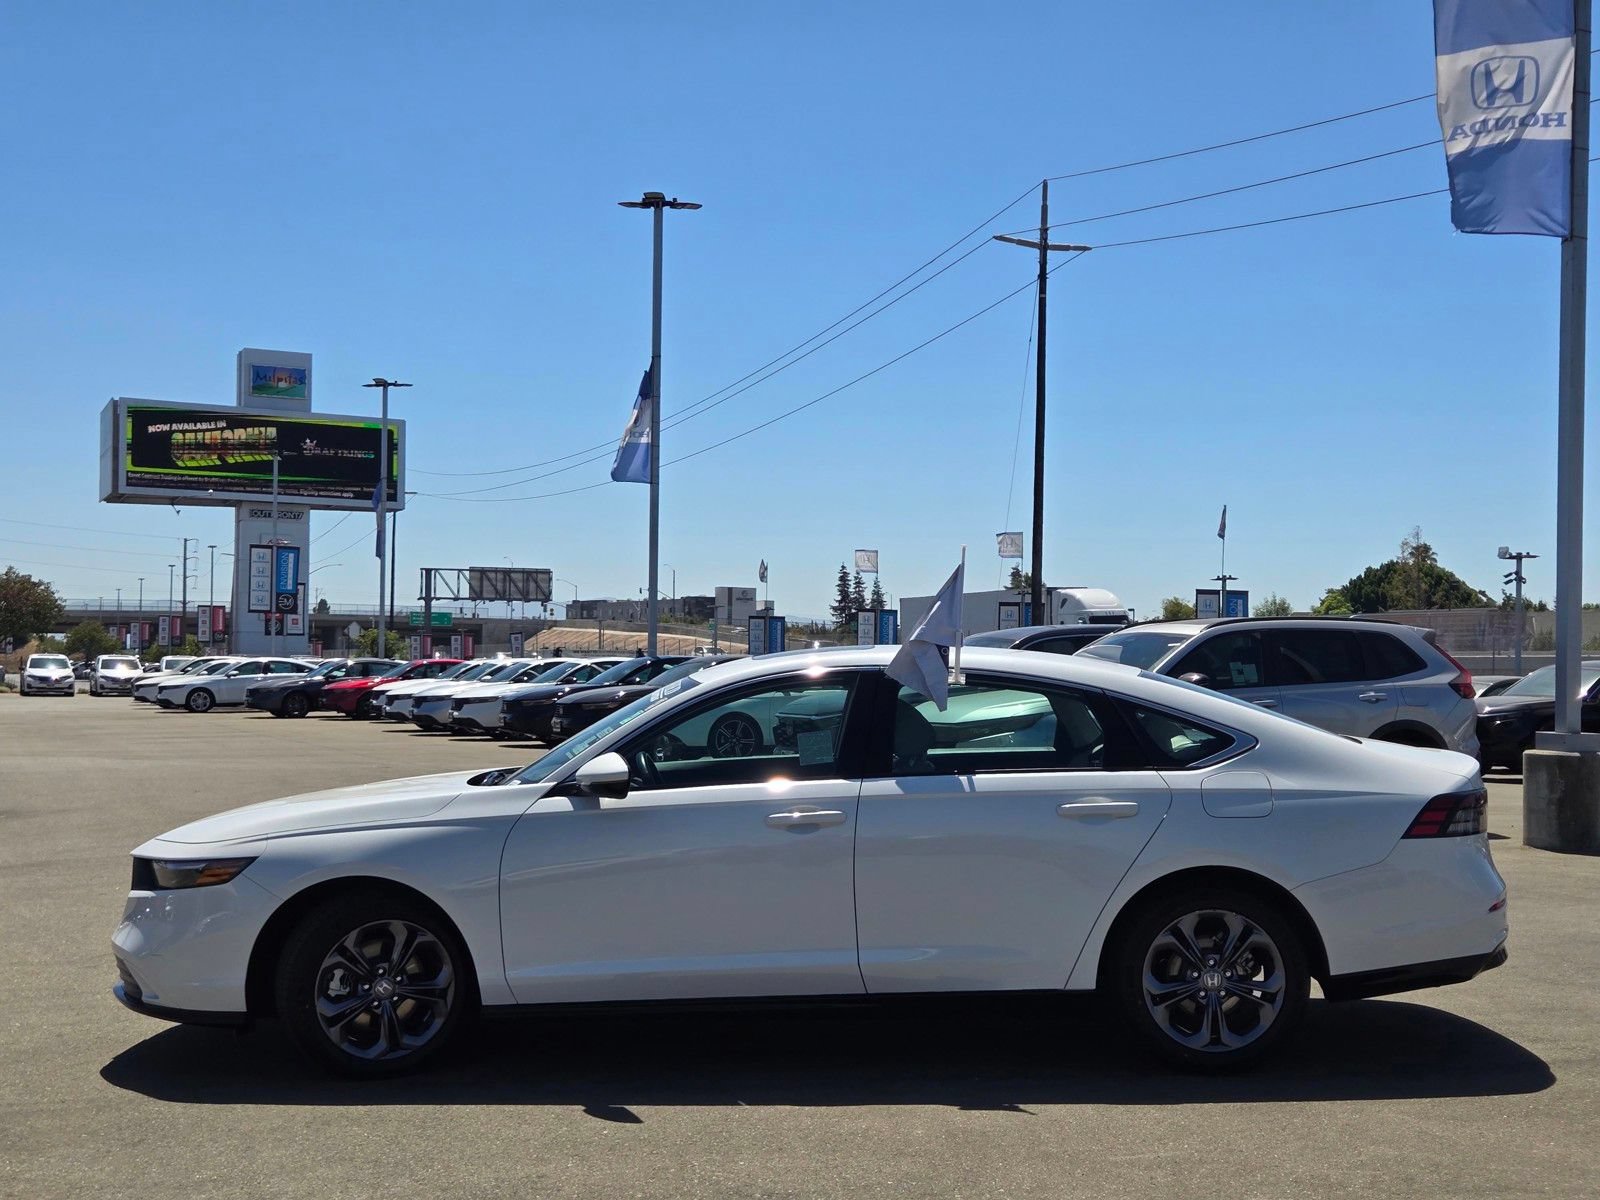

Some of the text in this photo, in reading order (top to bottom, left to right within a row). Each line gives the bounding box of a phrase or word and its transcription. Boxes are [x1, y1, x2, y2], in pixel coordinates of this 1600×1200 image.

[147, 419, 227, 433] NOW AVAILABLE IN
[280, 551, 289, 590] ENVISION
